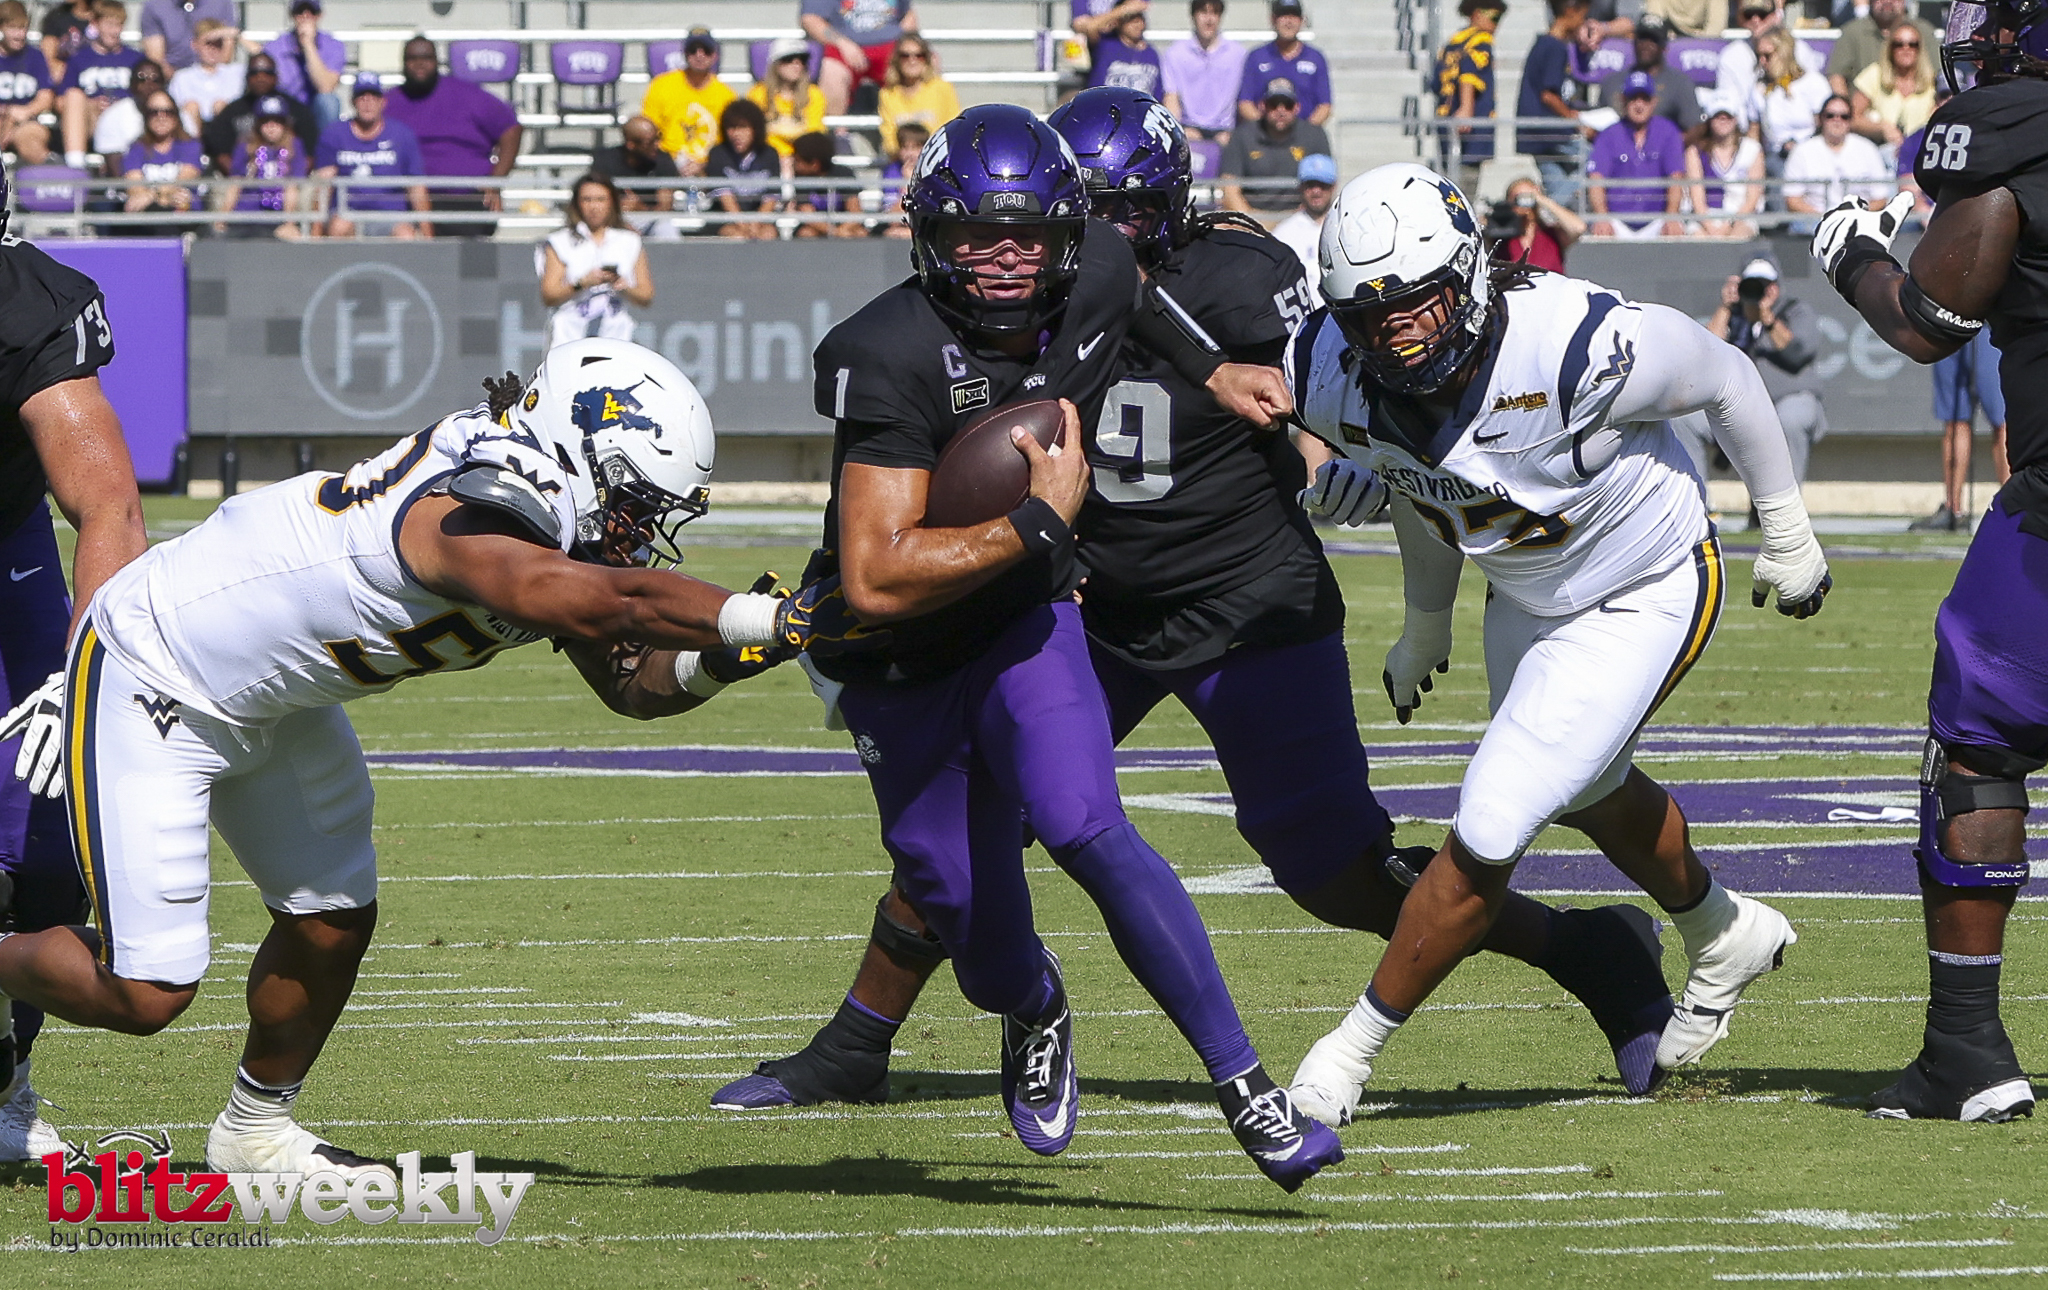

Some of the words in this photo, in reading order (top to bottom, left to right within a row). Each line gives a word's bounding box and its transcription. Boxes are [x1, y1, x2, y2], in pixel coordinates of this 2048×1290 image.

[1923, 124, 1972, 171] 58
[993, 193, 1026, 209] TCU
[1273, 277, 1312, 334] 59
[61, 299, 111, 365] 73
[941, 343, 967, 378] C
[833, 367, 850, 419] 1
[1024, 374, 1046, 391] TCU
[1507, 391, 1547, 407] Antero
[1984, 870, 2027, 878] DONJOY
